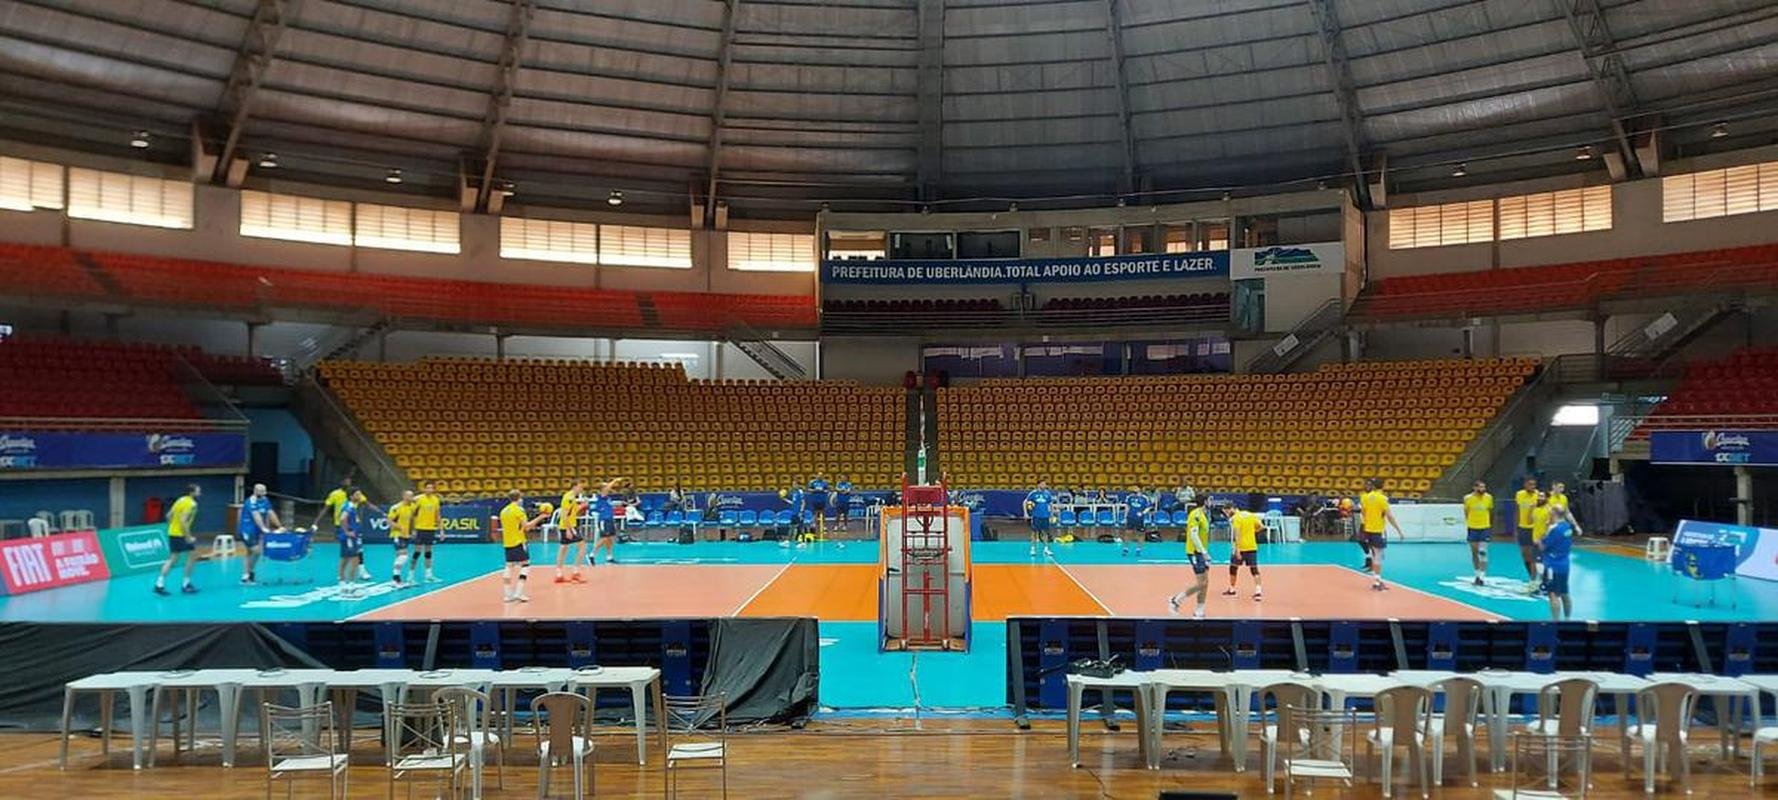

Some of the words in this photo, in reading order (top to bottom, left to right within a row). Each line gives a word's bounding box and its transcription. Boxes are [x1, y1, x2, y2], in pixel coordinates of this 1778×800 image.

[832, 265, 905, 279] PREFEITURA
[907, 266, 924, 279] DE
[1043, 264, 1081, 277] APOIO
[1083, 263, 1101, 276] AO
[1104, 260, 1160, 275] ESPORTE
[1162, 259, 1171, 272] E
[439, 517, 480, 531] RASIL
[3, 543, 53, 587] FIAT
